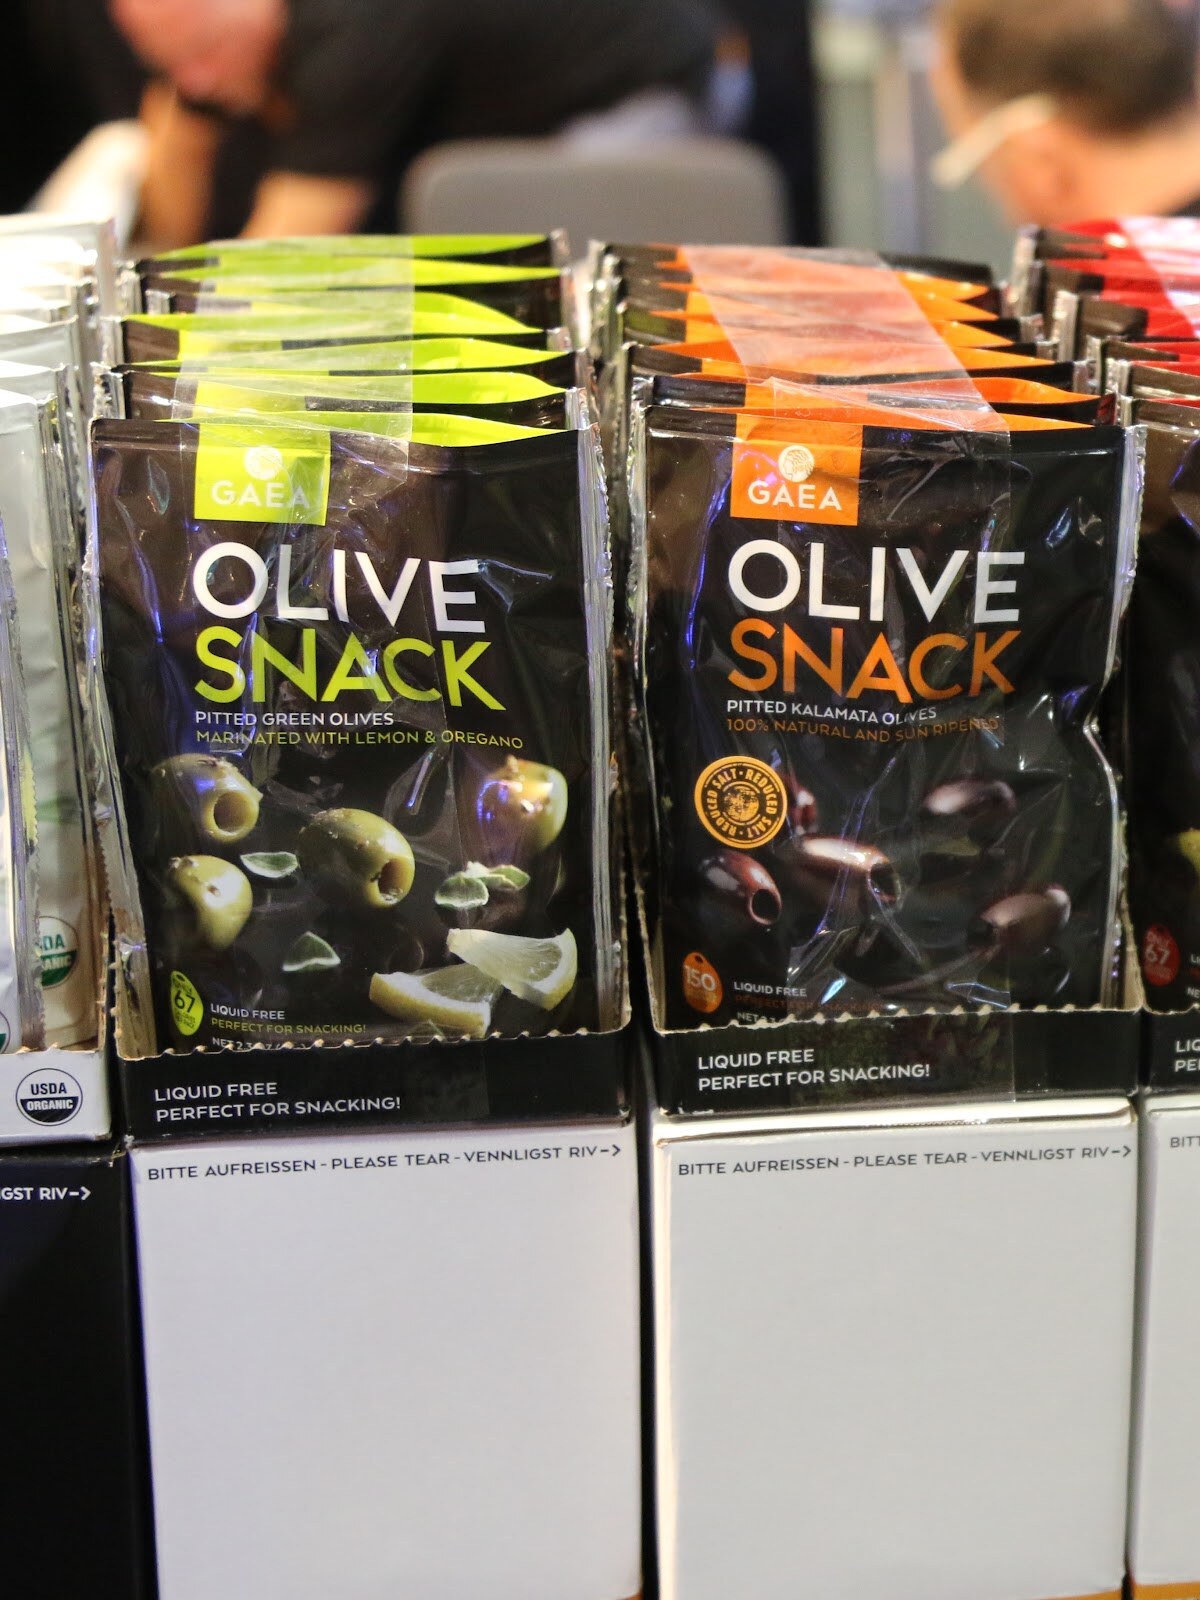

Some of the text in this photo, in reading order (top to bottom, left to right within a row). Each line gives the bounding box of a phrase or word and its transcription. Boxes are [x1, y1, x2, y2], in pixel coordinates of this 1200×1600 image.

[211, 480, 311, 510] GAEA
[747, 481, 842, 512] GAEA
[193, 541, 486, 633] OLIVE
[728, 539, 1026, 625] OLIVE
[195, 626, 506, 710] SNACK
[728, 617, 1021, 704] SNACK
[196, 711, 394, 726] PITTED GREEN OLIVES
[727, 700, 937, 726] PITTED KALAMATA OLIVES
[197, 730, 523, 749] MARINATED WITH LEMON & OREGANO
[727, 718, 769, 732] 100%
[774, 720, 850, 740] NATURAL
[855, 728, 890, 743] AND
[896, 726, 929, 742] SUN
[706, 768, 737, 836] REDUCED SALT
[745, 768, 778, 838] REDUCED SALT
[1145, 944, 1170, 964] 67
[175, 990, 195, 1013] 67
[734, 982, 807, 997] LIQUID FREE
[210, 1003, 285, 1020] LIQUID FREE
[211, 1018, 366, 1034] PERFECT FOR SNACKING!
[698, 1049, 815, 1070] LIQUID FREE
[31, 1082, 67, 1095] USDA
[699, 1063, 930, 1091] PERFECT FOR SNACKING!
[155, 1083, 278, 1101] LIQUID FREE
[26, 1099, 74, 1111] ORGANIC
[156, 1097, 401, 1122] PERFECT FOR SNACKING!
[148, 1146, 597, 1181] BITTE AUFREISSEN PLEASE TEAR VENNLIGST RIV
[678, 1146, 1109, 1176] BITTE AUFREISSEN PLEASE TEAR VENNLIGST RIV
[39, 1187, 68, 1200] RIV
